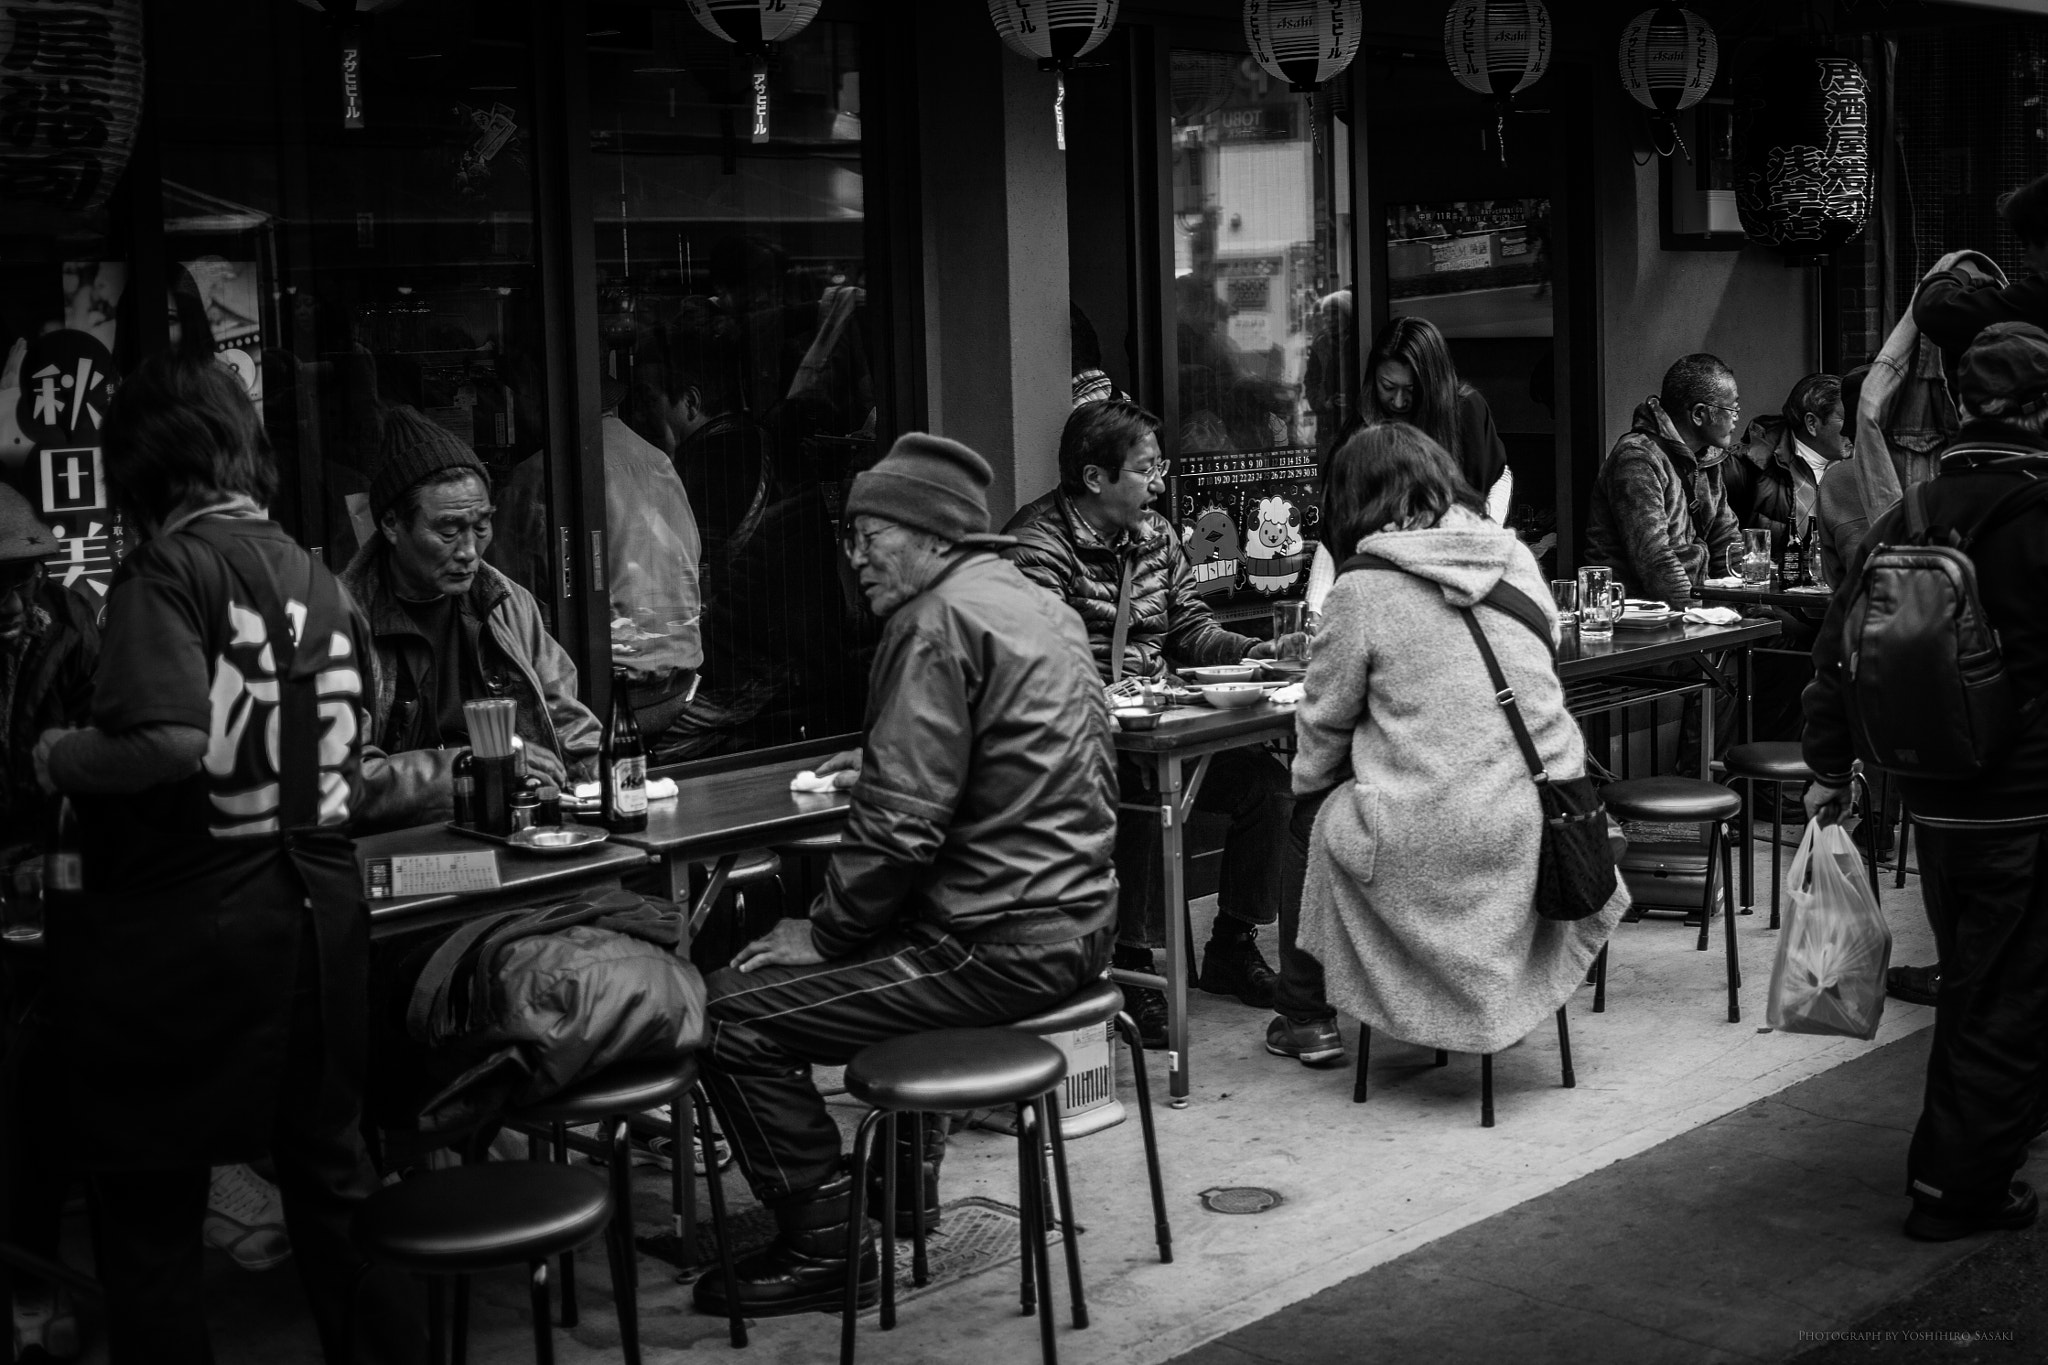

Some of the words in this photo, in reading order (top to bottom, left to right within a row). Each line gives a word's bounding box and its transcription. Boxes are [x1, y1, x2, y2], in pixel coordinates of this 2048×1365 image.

[1277, 16, 1313, 29] Asahi
[1462, 6, 1479, 74] アサヒビール
[1494, 30, 1528, 41] Asahi
[1531, 6, 1546, 72] アサヒビール
[344, 49, 361, 118] アサヒビール
[1628, 26, 1641, 88] アサヒビール
[1653, 51, 1684, 61] Asahi
[1688, 26, 1706, 88] アサヒビール
[753, 73, 767, 135] アサヒビール
[1190, 464, 1195, 473] 2
[1199, 464, 1203, 472] 3
[1215, 463, 1220, 471] 5
[1223, 462, 1229, 470] 6
[1232, 462, 1237, 470] 7
[1240, 460, 1245, 469] 8
[1248, 460, 1253, 468] 9
[1256, 460, 1263, 468] 10
[1280, 458, 1286, 466] 13
[1288, 457, 1294, 465] 14
[1296, 456, 1302, 464] 15
[1304, 456, 1310, 464] 16
[1198, 478, 1205, 486] 17
[1215, 476, 1221, 484] 19
[1232, 475, 1238, 483] 21
[1240, 474, 1247, 482] 22
[1256, 473, 1263, 481] 24
[1271, 471, 1278, 479] 26
[1279, 471, 1286, 479] 27
[1287, 470, 1294, 478] 28
[1295, 469, 1302, 477] 29
[1303, 469, 1310, 477] 30
[1311, 468, 1317, 476] 31
